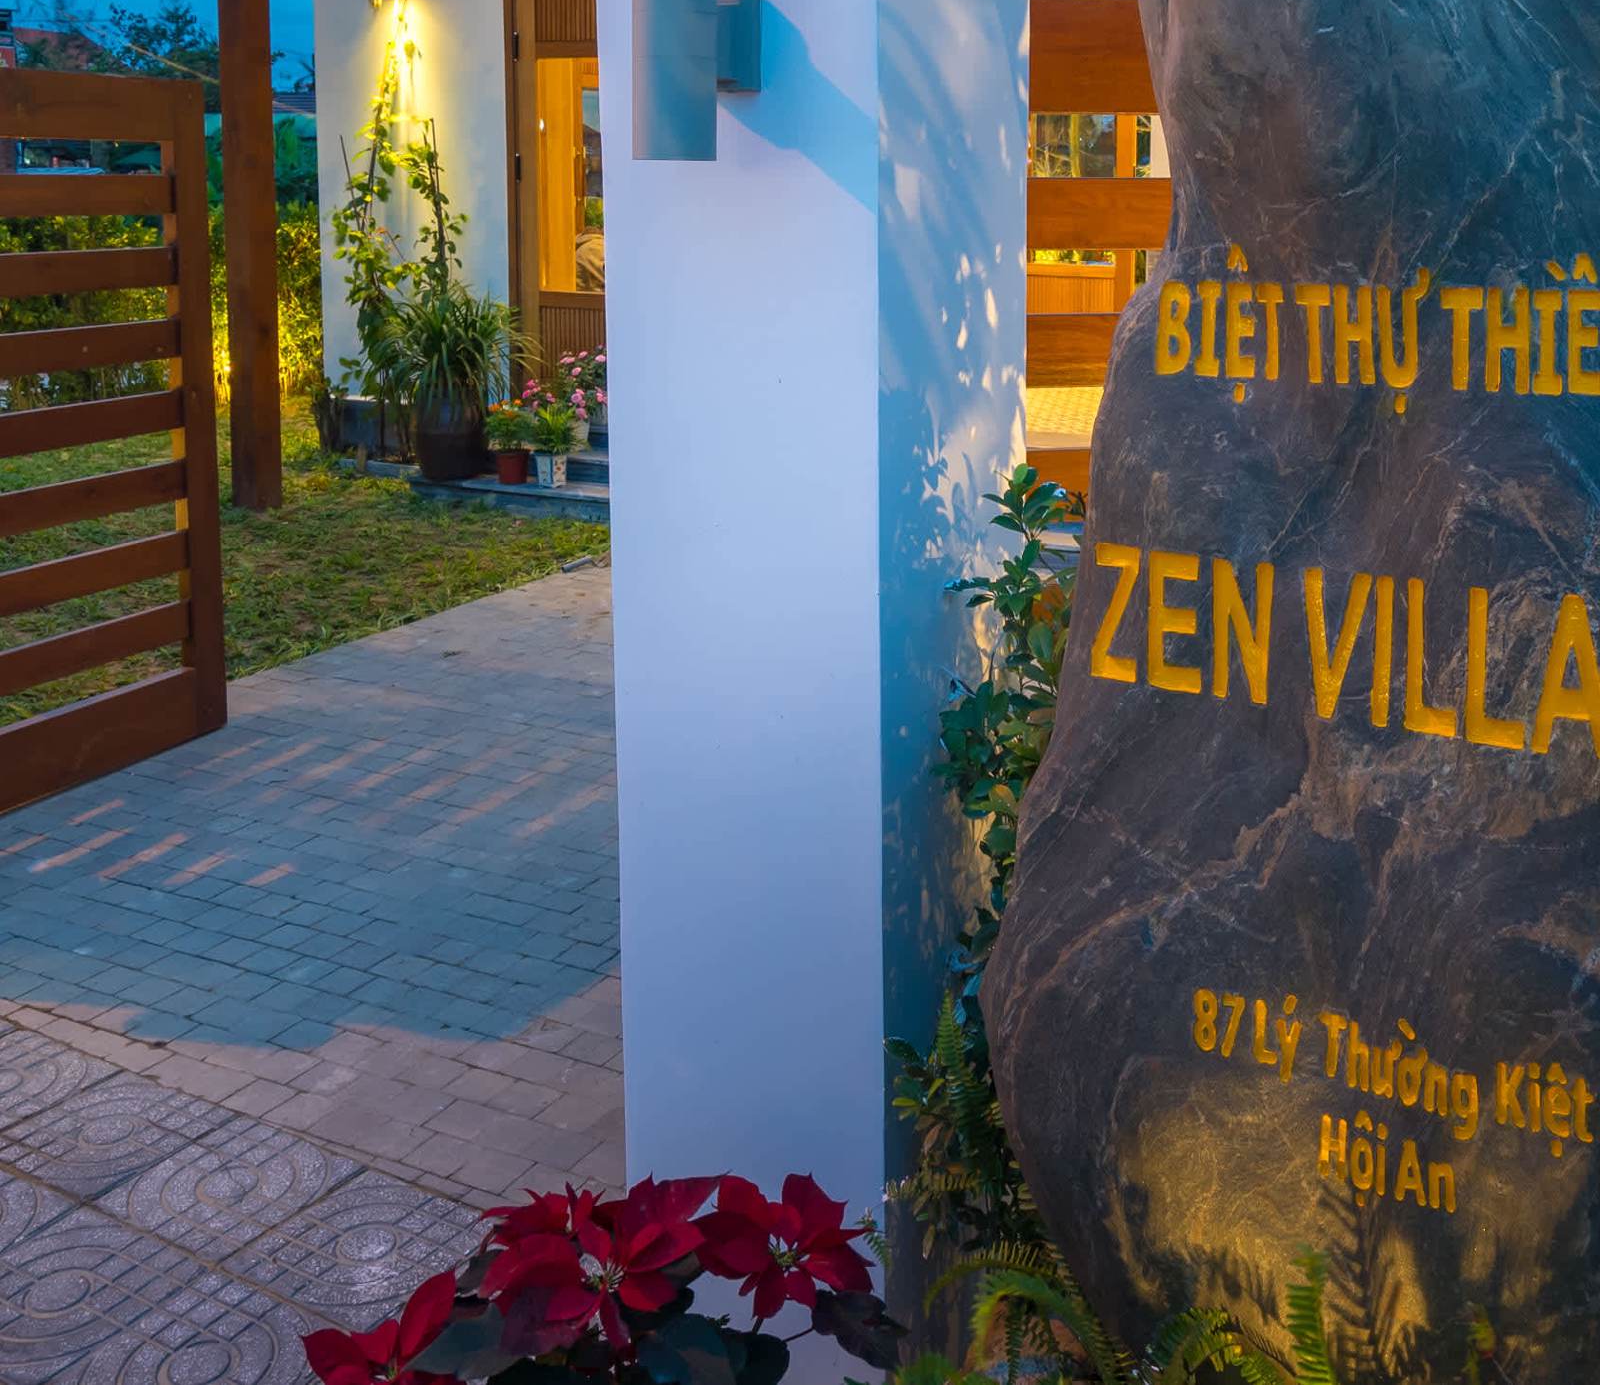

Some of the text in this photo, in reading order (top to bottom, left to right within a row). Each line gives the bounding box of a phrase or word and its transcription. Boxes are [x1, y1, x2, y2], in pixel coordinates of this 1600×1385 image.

[1154, 244, 1283, 403] BIỆT
[1296, 267, 1430, 414] THỰ
[1091, 542, 1600, 760] ZEN VILLA
[1193, 988, 1594, 1159] 87 Lý Thường Kiệt
[1318, 1110, 1457, 1214] Hội An
